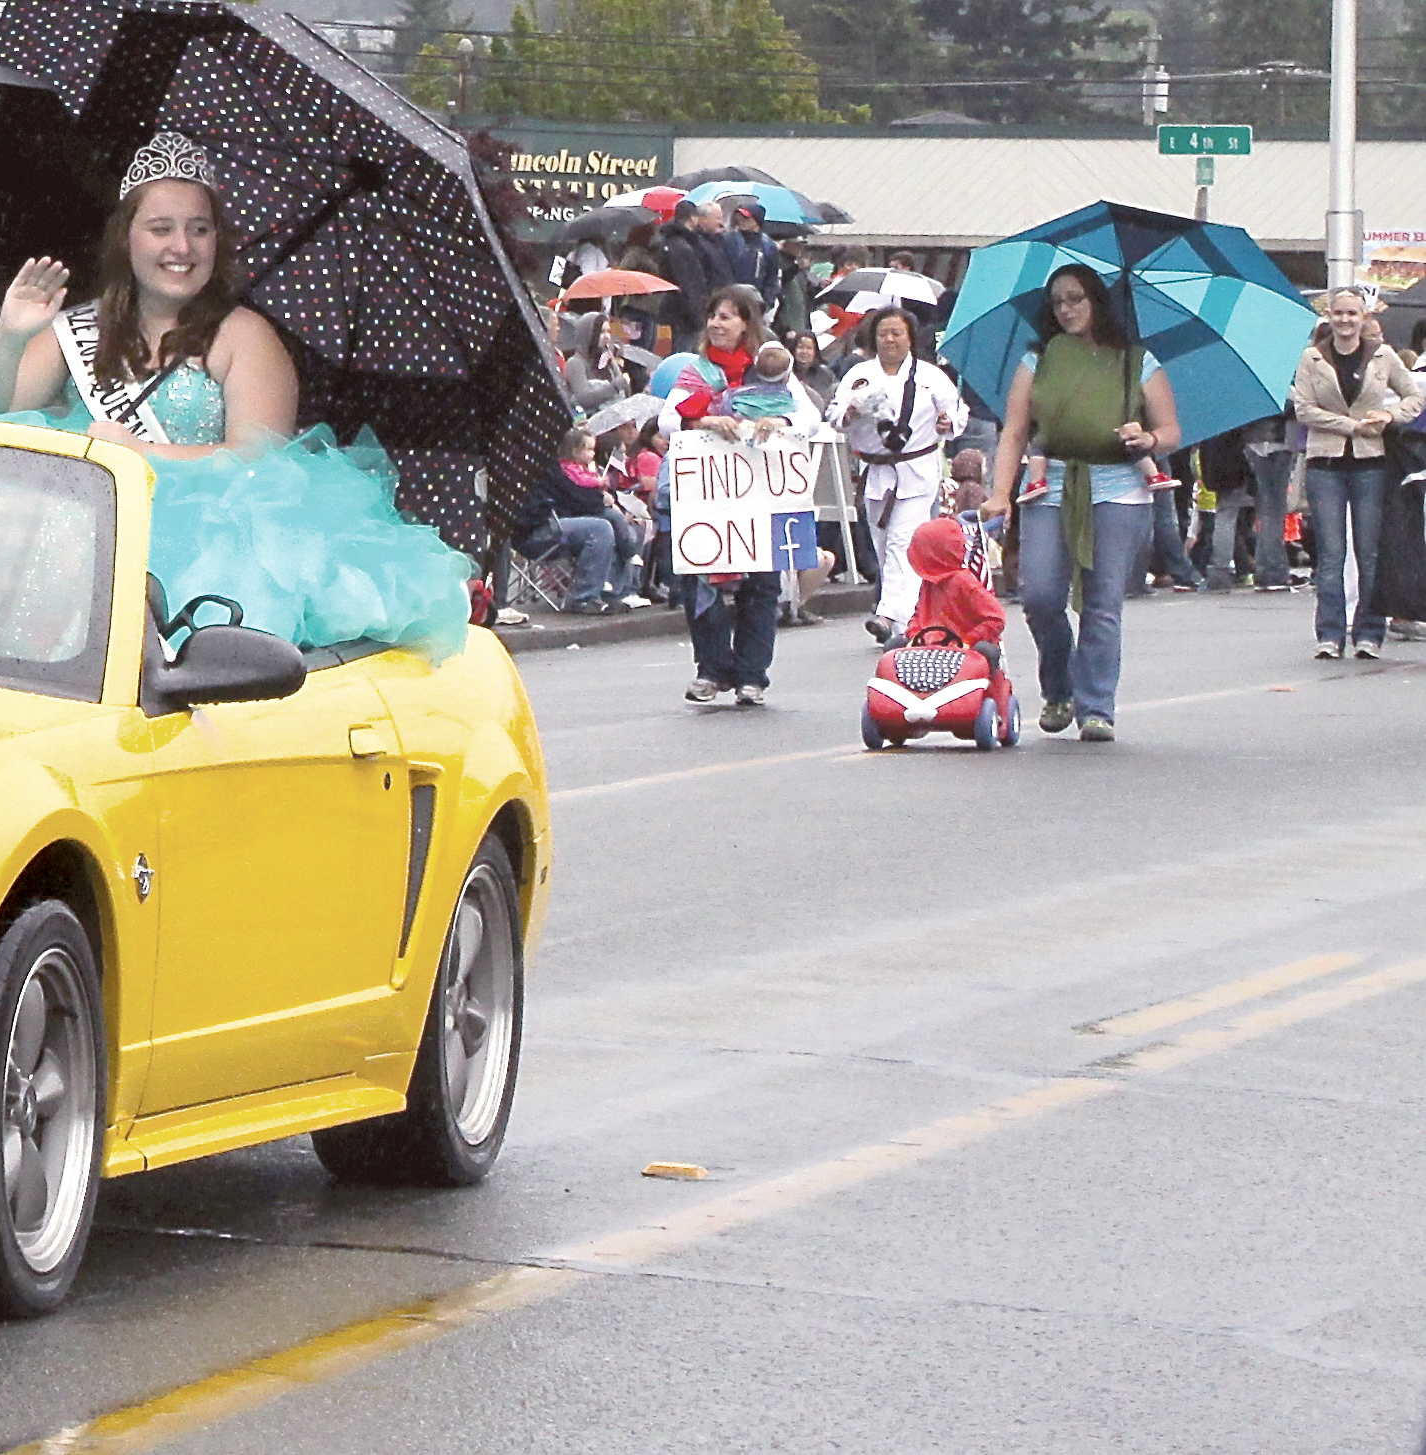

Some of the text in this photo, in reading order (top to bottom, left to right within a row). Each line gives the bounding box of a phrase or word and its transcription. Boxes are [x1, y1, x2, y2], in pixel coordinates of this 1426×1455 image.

[1189, 132, 1214, 149] 4th
[1228, 137, 1238, 149] St
[510, 149, 658, 177] incoln Street
[1363, 232, 1410, 241] UMMER
[675, 450, 809, 501] FIND US
[678, 518, 756, 567] ON
